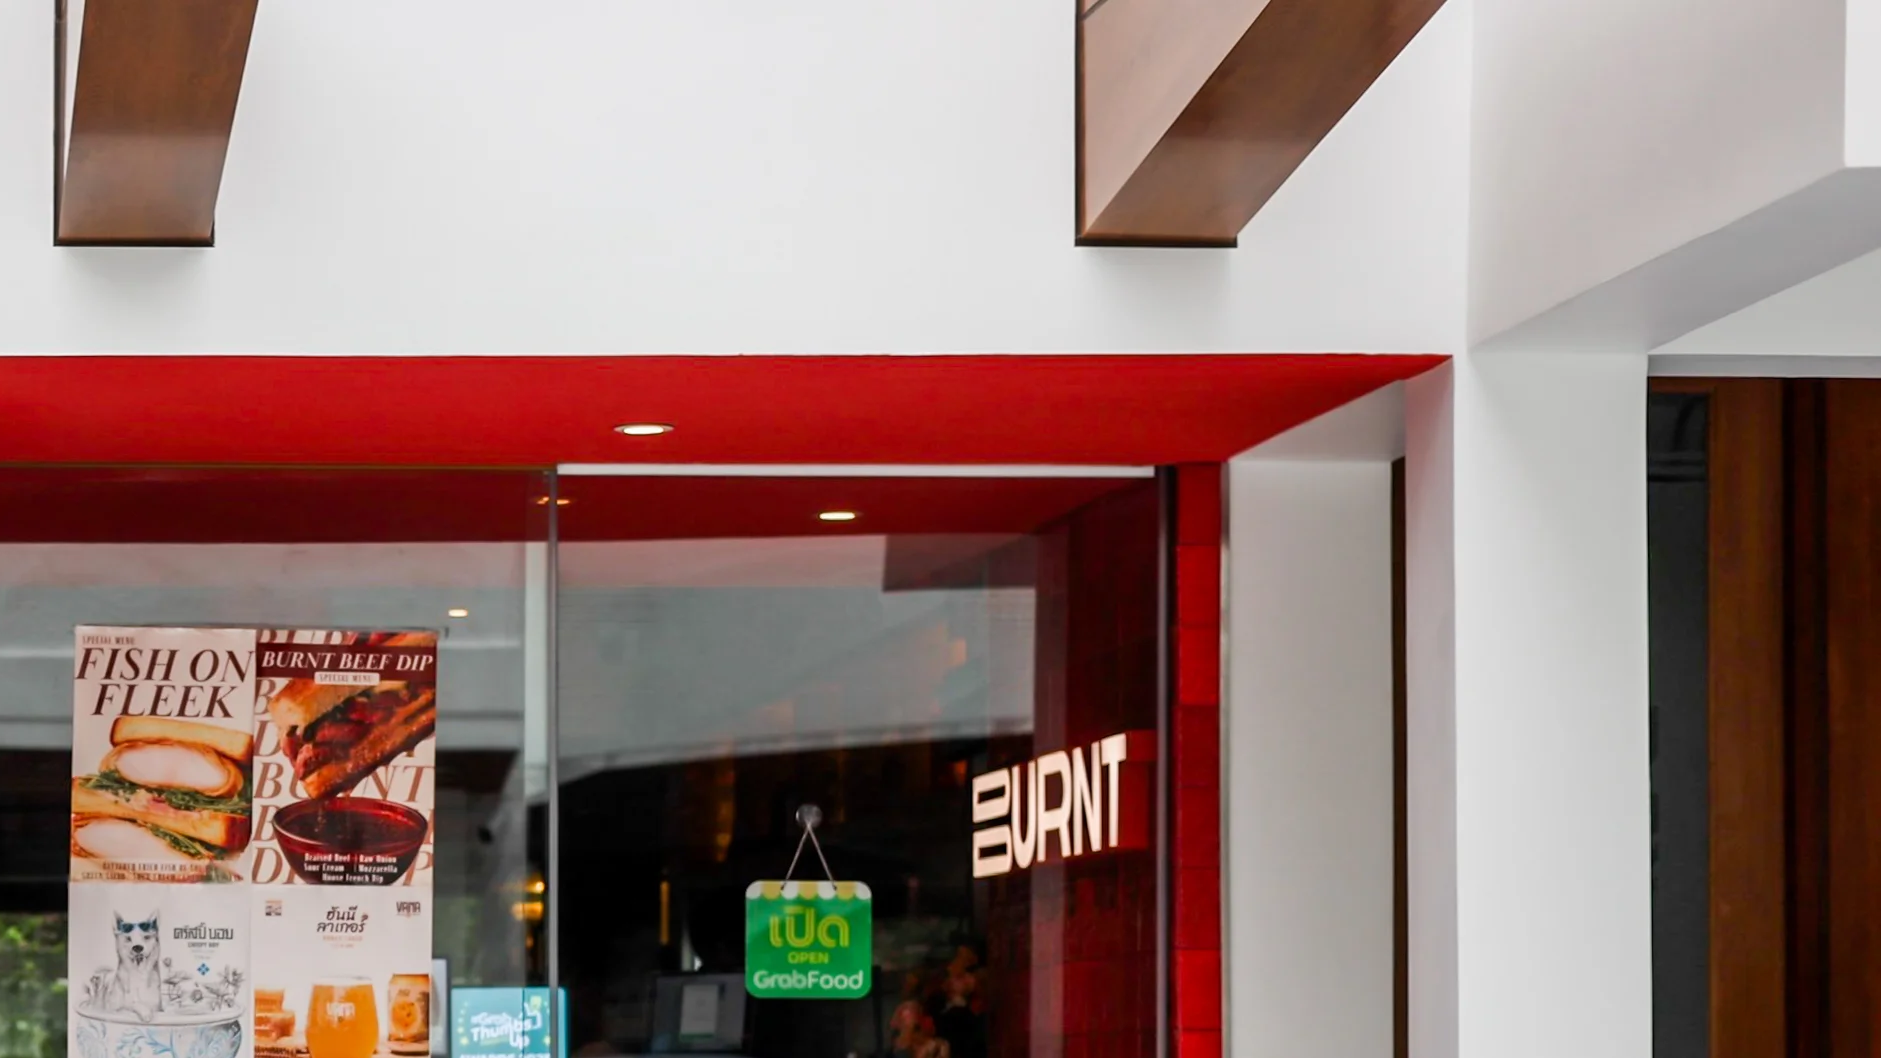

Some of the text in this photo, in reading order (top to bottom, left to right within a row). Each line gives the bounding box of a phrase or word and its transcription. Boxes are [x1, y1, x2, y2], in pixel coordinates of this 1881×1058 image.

[82, 636, 135, 646] SPECIAL MENU
[75, 647, 255, 683] FISH ON
[261, 650, 433, 672] BURNT BEEF DIP
[91, 683, 239, 718] FLEEK
[972, 732, 1127, 879] BURNT
[303, 863, 398, 873] Sour Cream Mozzarella
[304, 853, 397, 864] Braised Beef Raw Onion
[322, 873, 384, 884] House French Dip
[787, 951, 829, 964] OPEN
[753, 970, 864, 989] GrabFood
[470, 1018, 532, 1042] Thumbs
